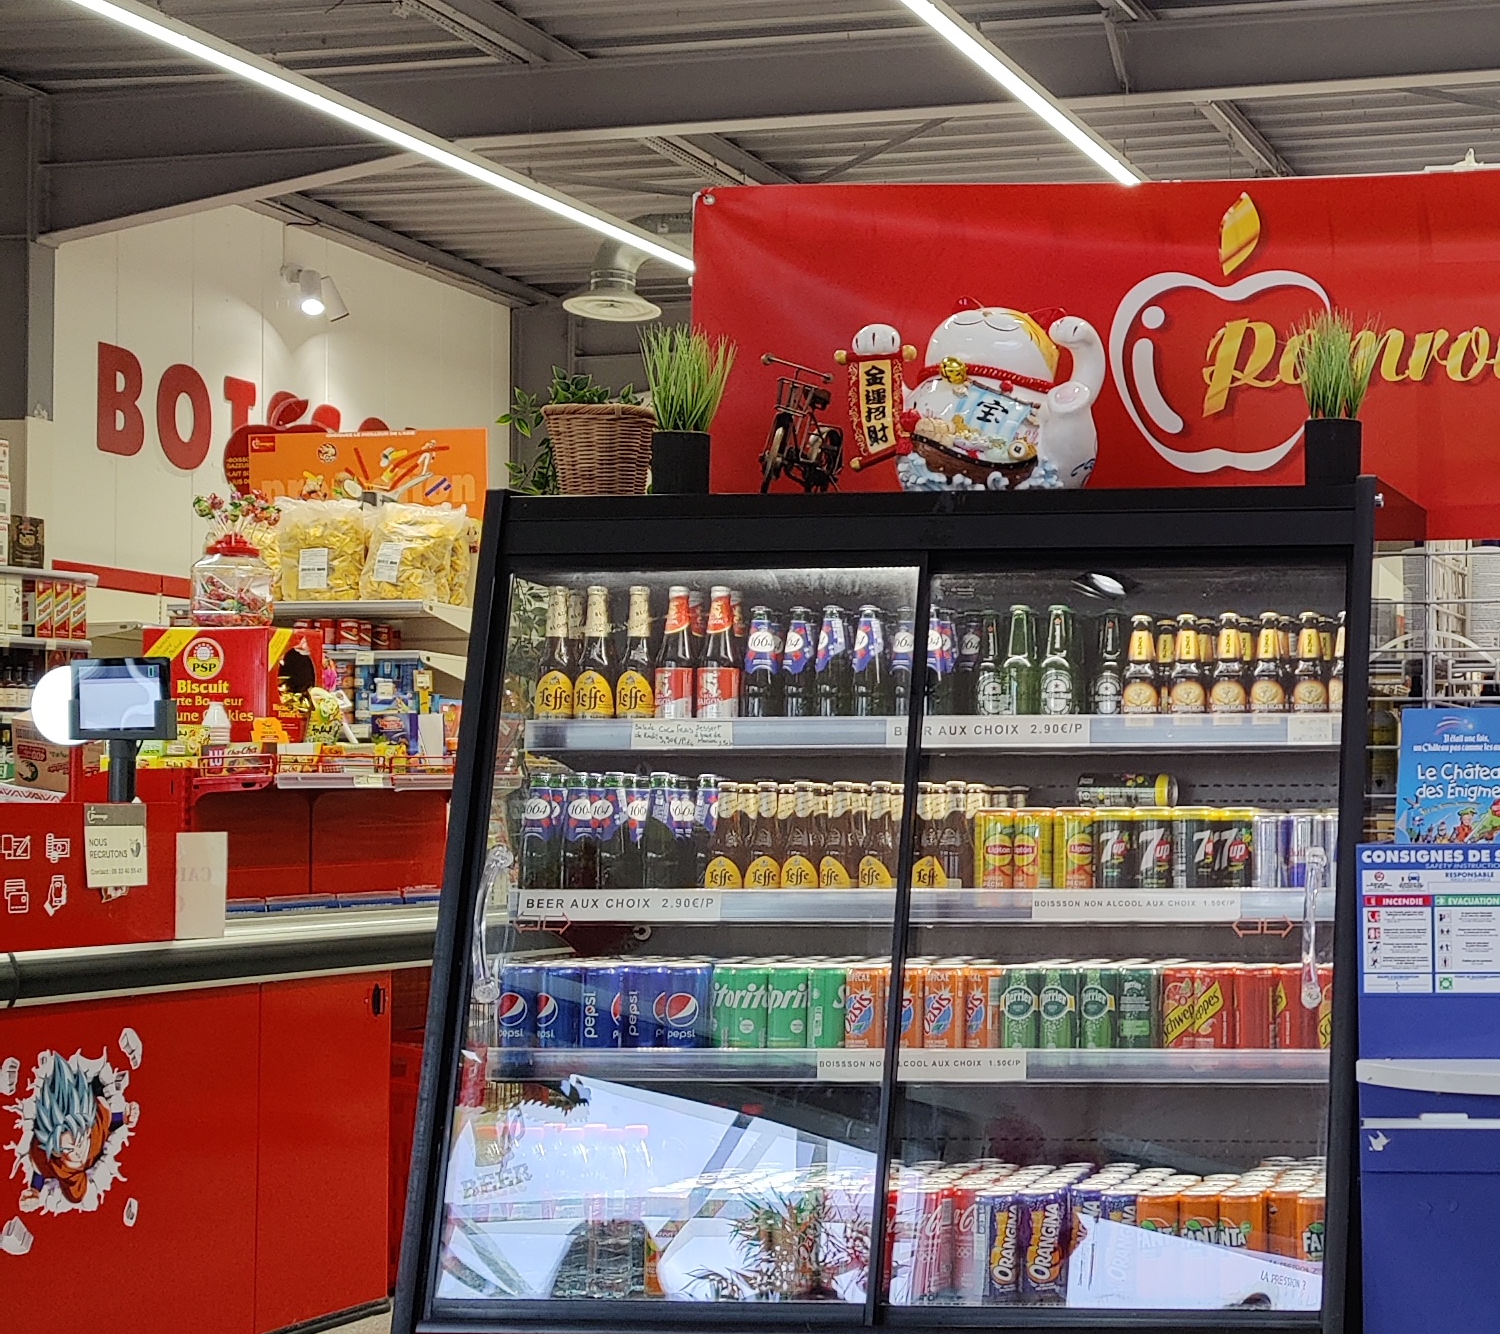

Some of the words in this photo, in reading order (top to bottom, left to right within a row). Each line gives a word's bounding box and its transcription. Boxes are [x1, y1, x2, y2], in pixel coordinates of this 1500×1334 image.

[865, 364, 889, 447] 金運招財
[192, 662, 217, 673] PSP
[176, 679, 230, 694] Biscuit
[540, 687, 571, 710] Leffe
[576, 687, 606, 710] Leffe
[618, 686, 647, 710] Leffe
[939, 725, 967, 736] AUX
[974, 724, 1019, 735] CHOIX
[1030, 723, 1083, 734] 2.90€/P
[1417, 764, 1437, 780] Le
[1416, 783, 1444, 799] des
[89, 838, 107, 847] NOUS
[1361, 849, 1464, 864] CONSIGNES
[1468, 849, 1490, 863] DE
[709, 868, 733, 885] Leffe
[752, 868, 777, 885] Leffe
[786, 868, 810, 885] Leffe
[1445, 871, 1494, 879] RESPONSABLE
[526, 897, 564, 910] BEER
[570, 897, 599, 910] AUX
[605, 897, 650, 910] CHOIX
[661, 896, 714, 910] 2.90€/P
[1167, 899, 1197, 907] CHOIX
[1382, 897, 1424, 906] INCENDIE
[584, 991, 599, 1039] pepsi
[629, 991, 640, 1037] pepsi
[667, 1029, 696, 1040] pepsi
[931, 1059, 950, 1067] AUX
[953, 1059, 982, 1067] CHOIX
[461, 1163, 532, 1200] BEER
[993, 1204, 1018, 1281] ORANGINA
[1028, 1204, 1060, 1280] ORANGINA
